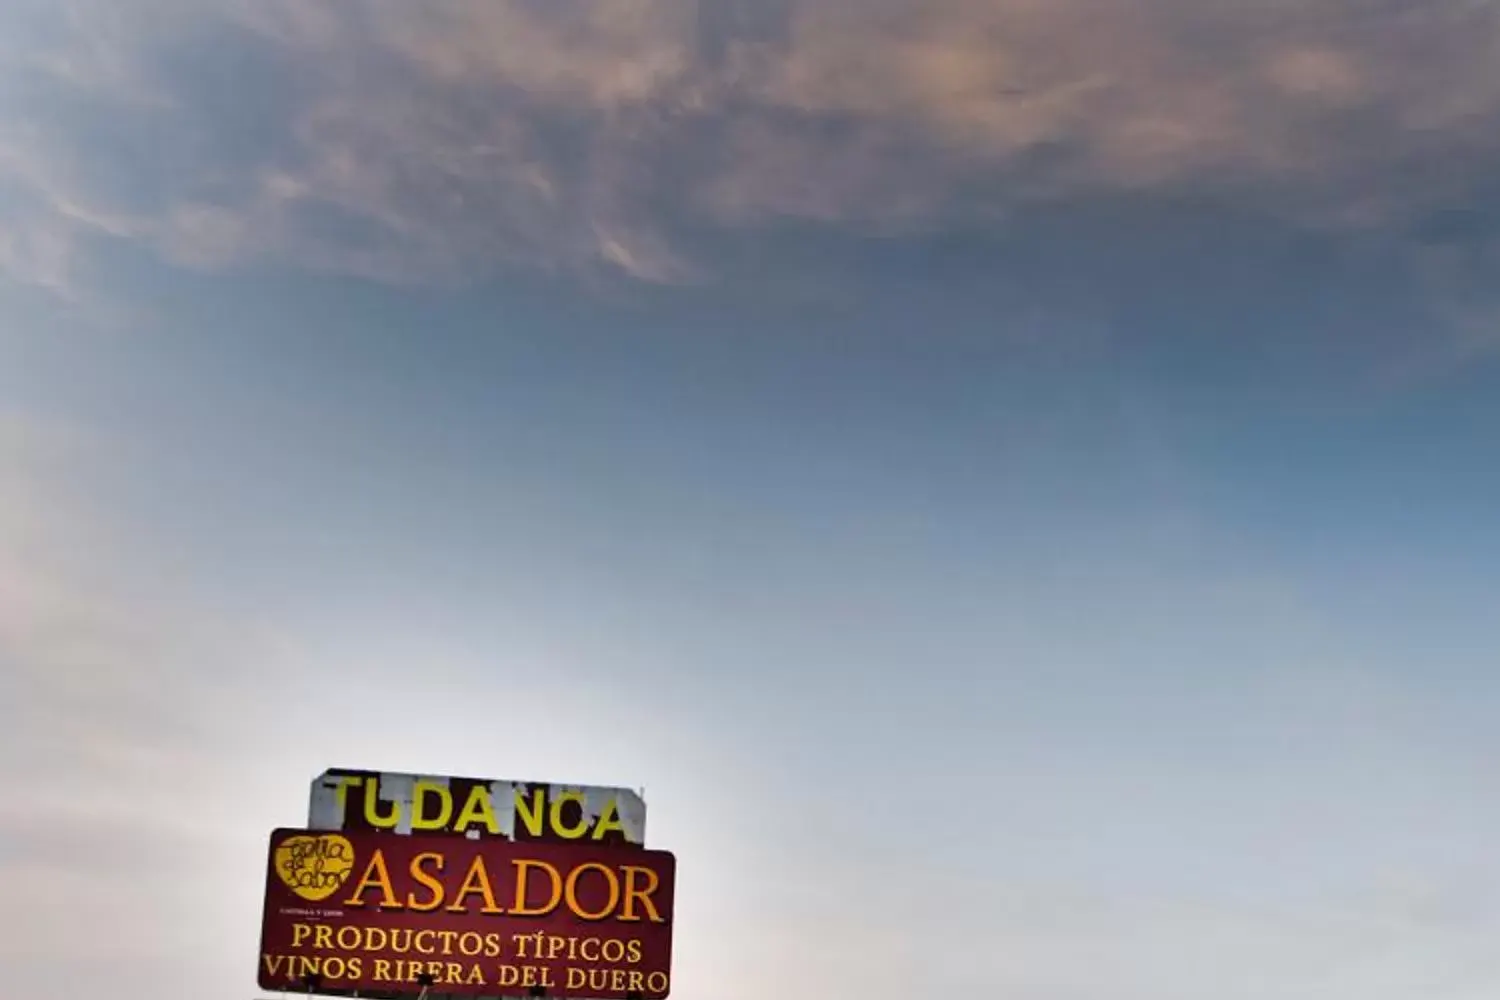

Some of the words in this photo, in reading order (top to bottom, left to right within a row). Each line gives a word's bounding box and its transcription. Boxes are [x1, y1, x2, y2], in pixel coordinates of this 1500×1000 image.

[325, 775, 634, 843] TUDANCA
[343, 848, 665, 923] ASADOR
[290, 923, 500, 958] PRODUCTOS
[513, 930, 642, 963] TÍPICOS
[263, 953, 362, 980] VINOS
[372, 959, 487, 986] RIBERA
[498, 964, 555, 988] DEL
[566, 968, 667, 993] DUERO
